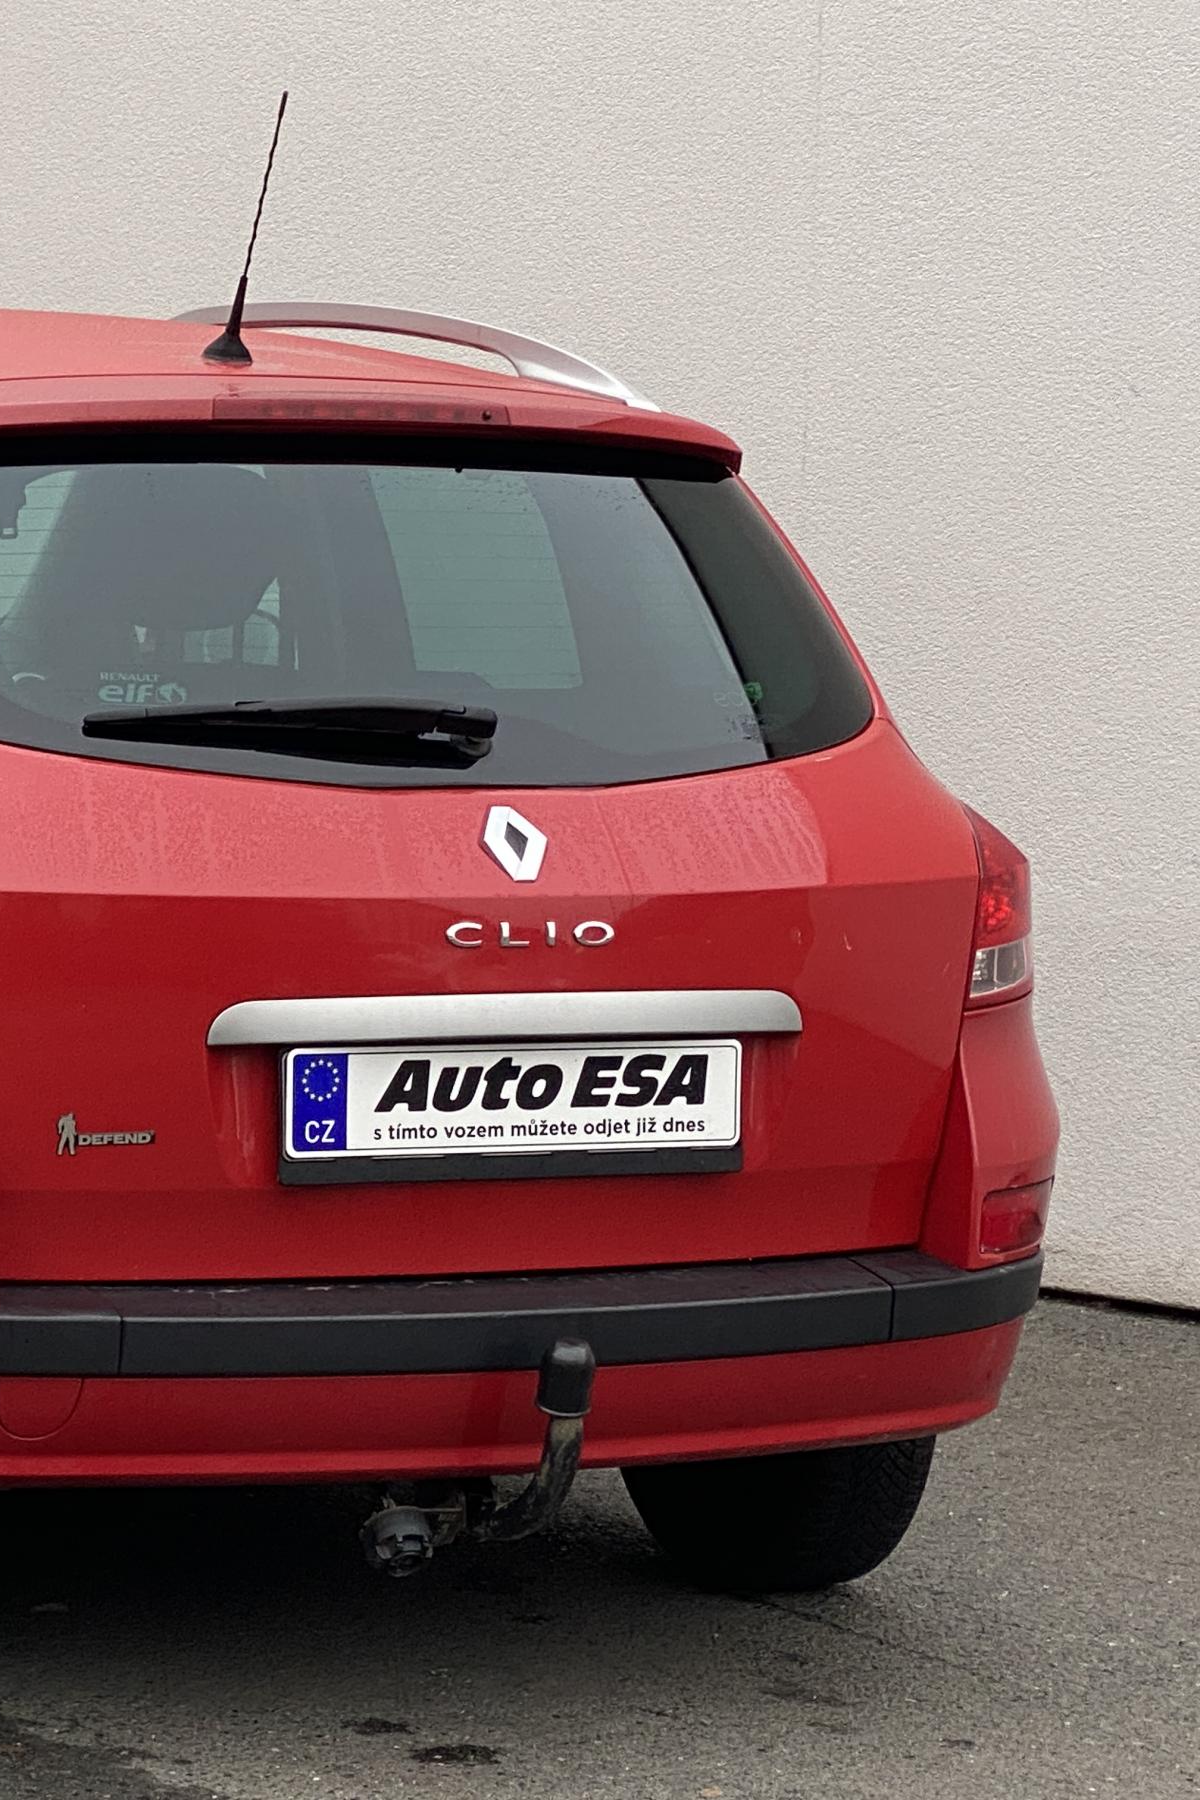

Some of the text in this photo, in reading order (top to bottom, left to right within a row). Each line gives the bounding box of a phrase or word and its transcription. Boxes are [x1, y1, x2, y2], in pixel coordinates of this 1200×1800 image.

[99, 671, 161, 682] RENAULT
[98, 683, 154, 703] elf
[445, 920, 615, 948] CLIO
[373, 1053, 709, 1113] Auto ESA
[78, 1132, 152, 1146] DEFEND
[303, 1120, 336, 1144] CZ
[373, 1117, 705, 1140] s tímto vozem můžete odjet již dnes
